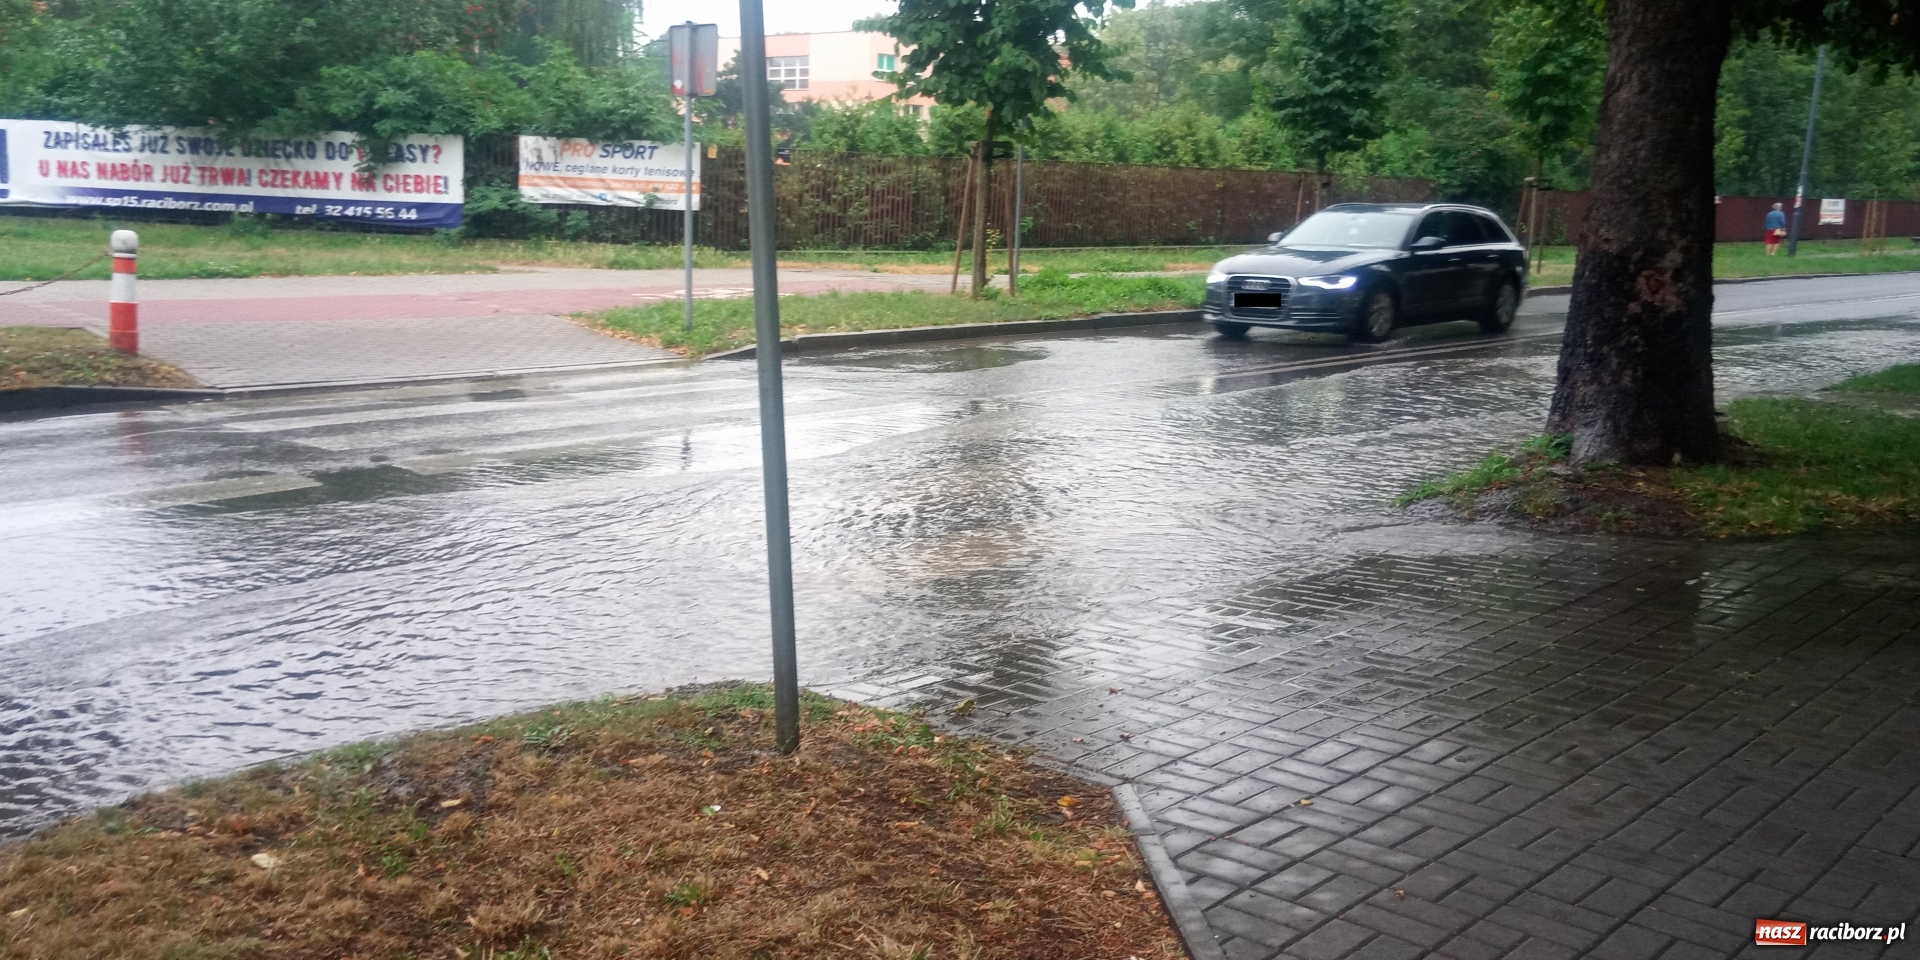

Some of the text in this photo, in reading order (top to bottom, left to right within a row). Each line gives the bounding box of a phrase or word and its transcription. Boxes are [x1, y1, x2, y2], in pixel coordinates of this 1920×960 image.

[138, 132, 170, 154] JUŻ
[241, 138, 317, 160] DIECKO
[325, 141, 350, 161] DO
[368, 143, 443, 164] ASY?
[560, 142, 659, 160] PRO SPORT
[38, 159, 50, 178] U
[56, 160, 91, 180] NAS
[96, 159, 154, 183] NABÓR
[161, 162, 191, 185] JUŻ
[257, 168, 344, 191] CZEKAMY
[350, 171, 377, 192] NA
[382, 173, 449, 195] CIEBIE!
[565, 163, 608, 175] ceglane
[611, 165, 640, 178] korty
[64, 195, 254, 213] www.sp15.raciborz.com.pl
[324, 205, 343, 216] 32
[343, 206, 373, 218] 415
[375, 207, 395, 219] 56
[397, 208, 418, 220] 44
